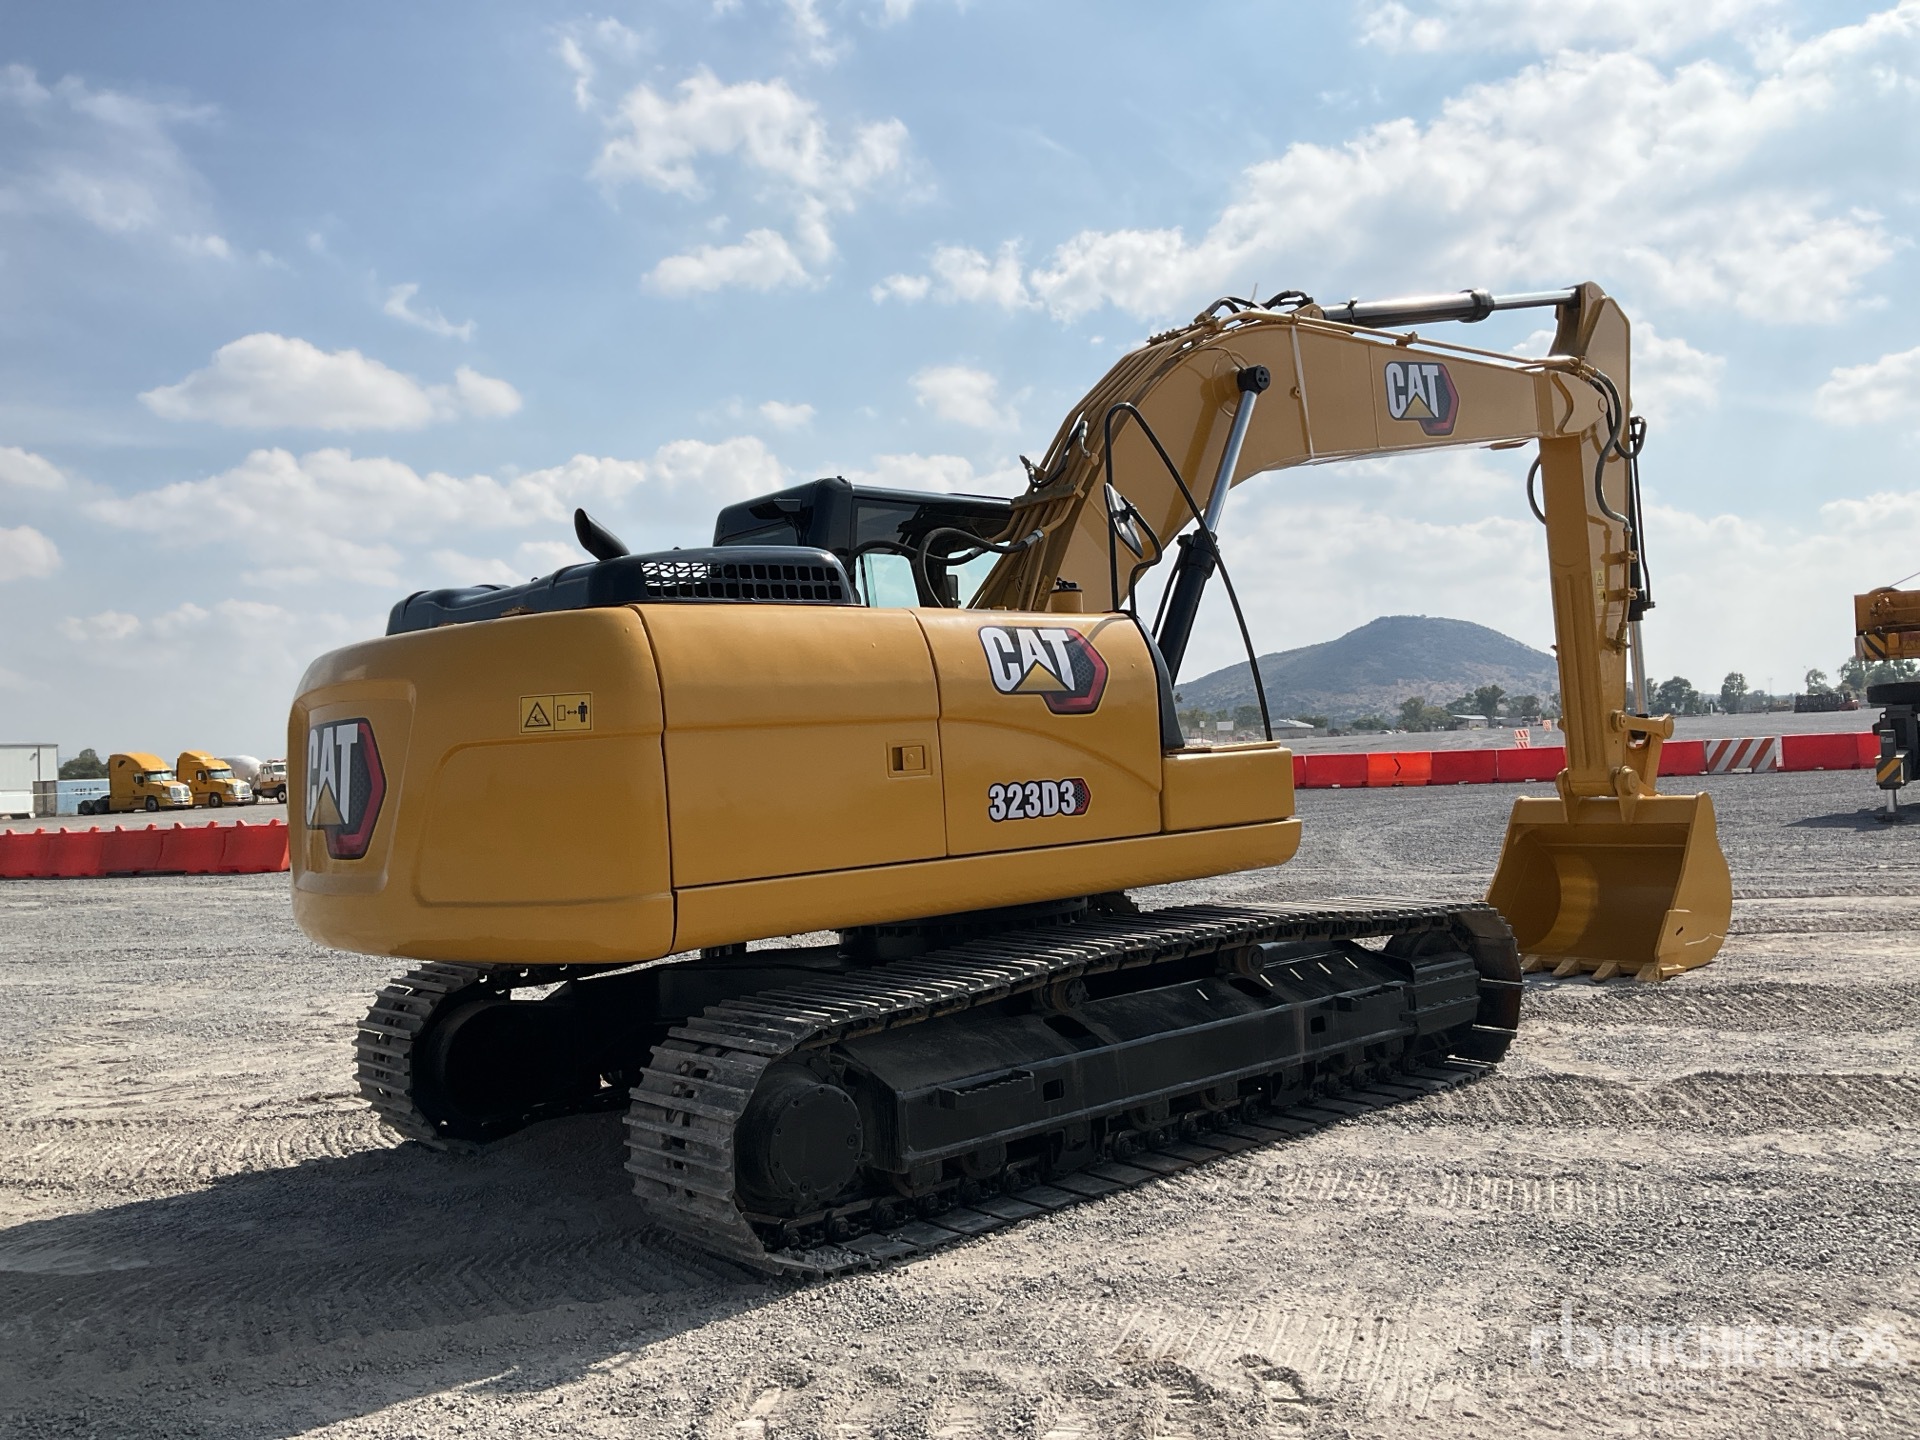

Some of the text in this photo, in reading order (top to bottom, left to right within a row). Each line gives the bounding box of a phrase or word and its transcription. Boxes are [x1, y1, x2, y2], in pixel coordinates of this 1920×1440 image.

[1386, 363, 1439, 418] CAT
[981, 628, 1075, 691] CAT
[306, 723, 358, 825] CAT
[990, 782, 1077, 820] 323D3
